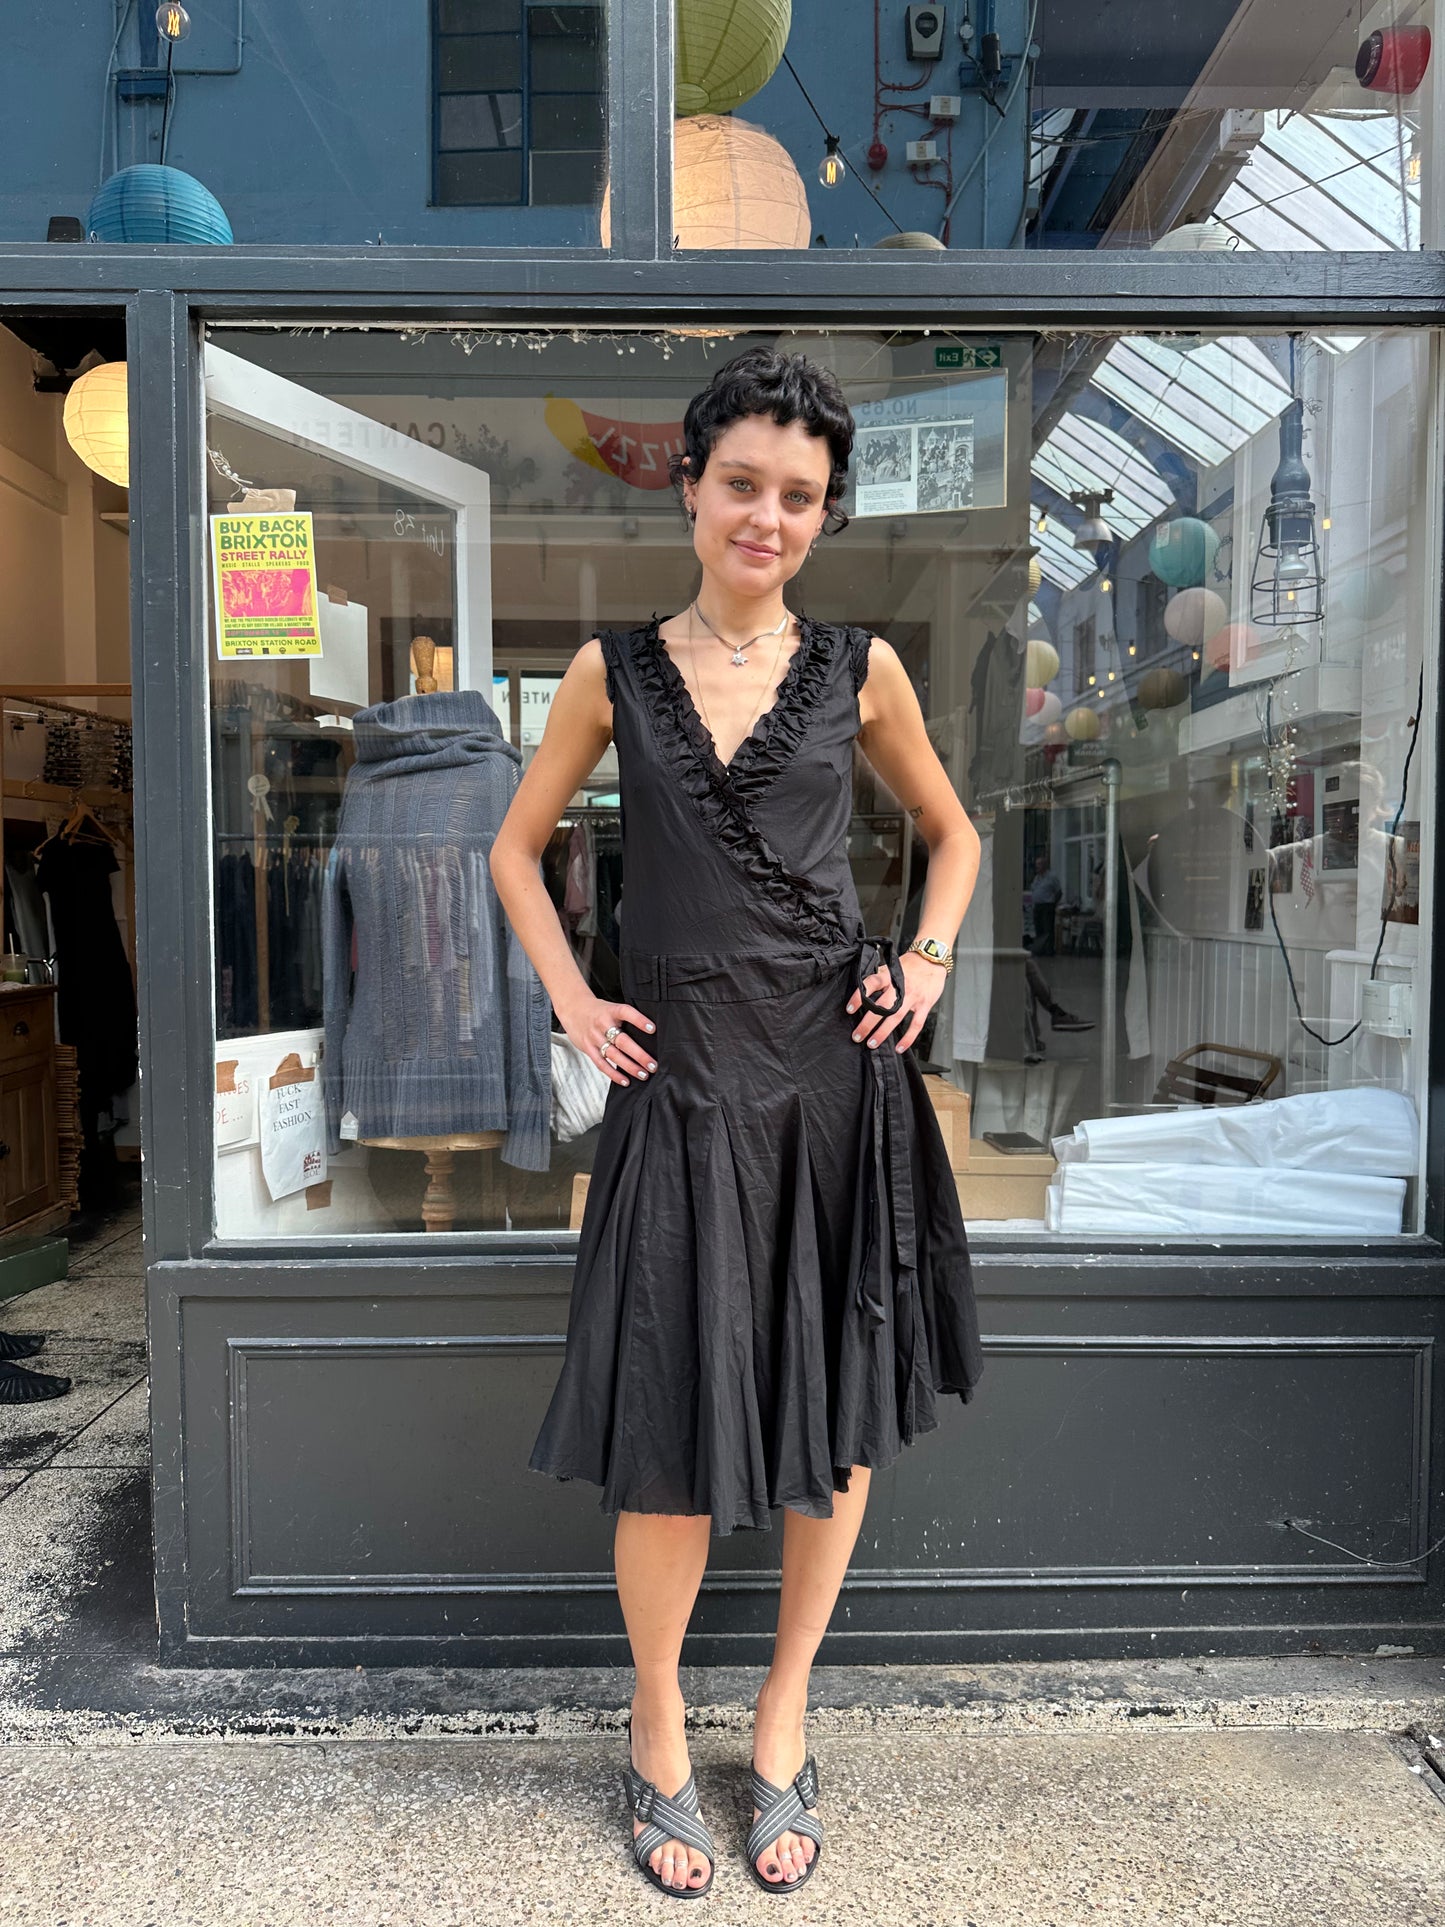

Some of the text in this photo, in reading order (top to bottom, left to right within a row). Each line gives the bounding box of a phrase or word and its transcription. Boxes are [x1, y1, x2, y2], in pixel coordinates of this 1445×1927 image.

[220, 519, 306, 534] BUY BACK
[220, 533, 308, 550] BRIXTON
[220, 550, 307, 562] STREET RALLY
[277, 1083, 301, 1099] FUCK
[279, 1098, 300, 1113] FAST
[273, 1110, 312, 1132] FASHION
